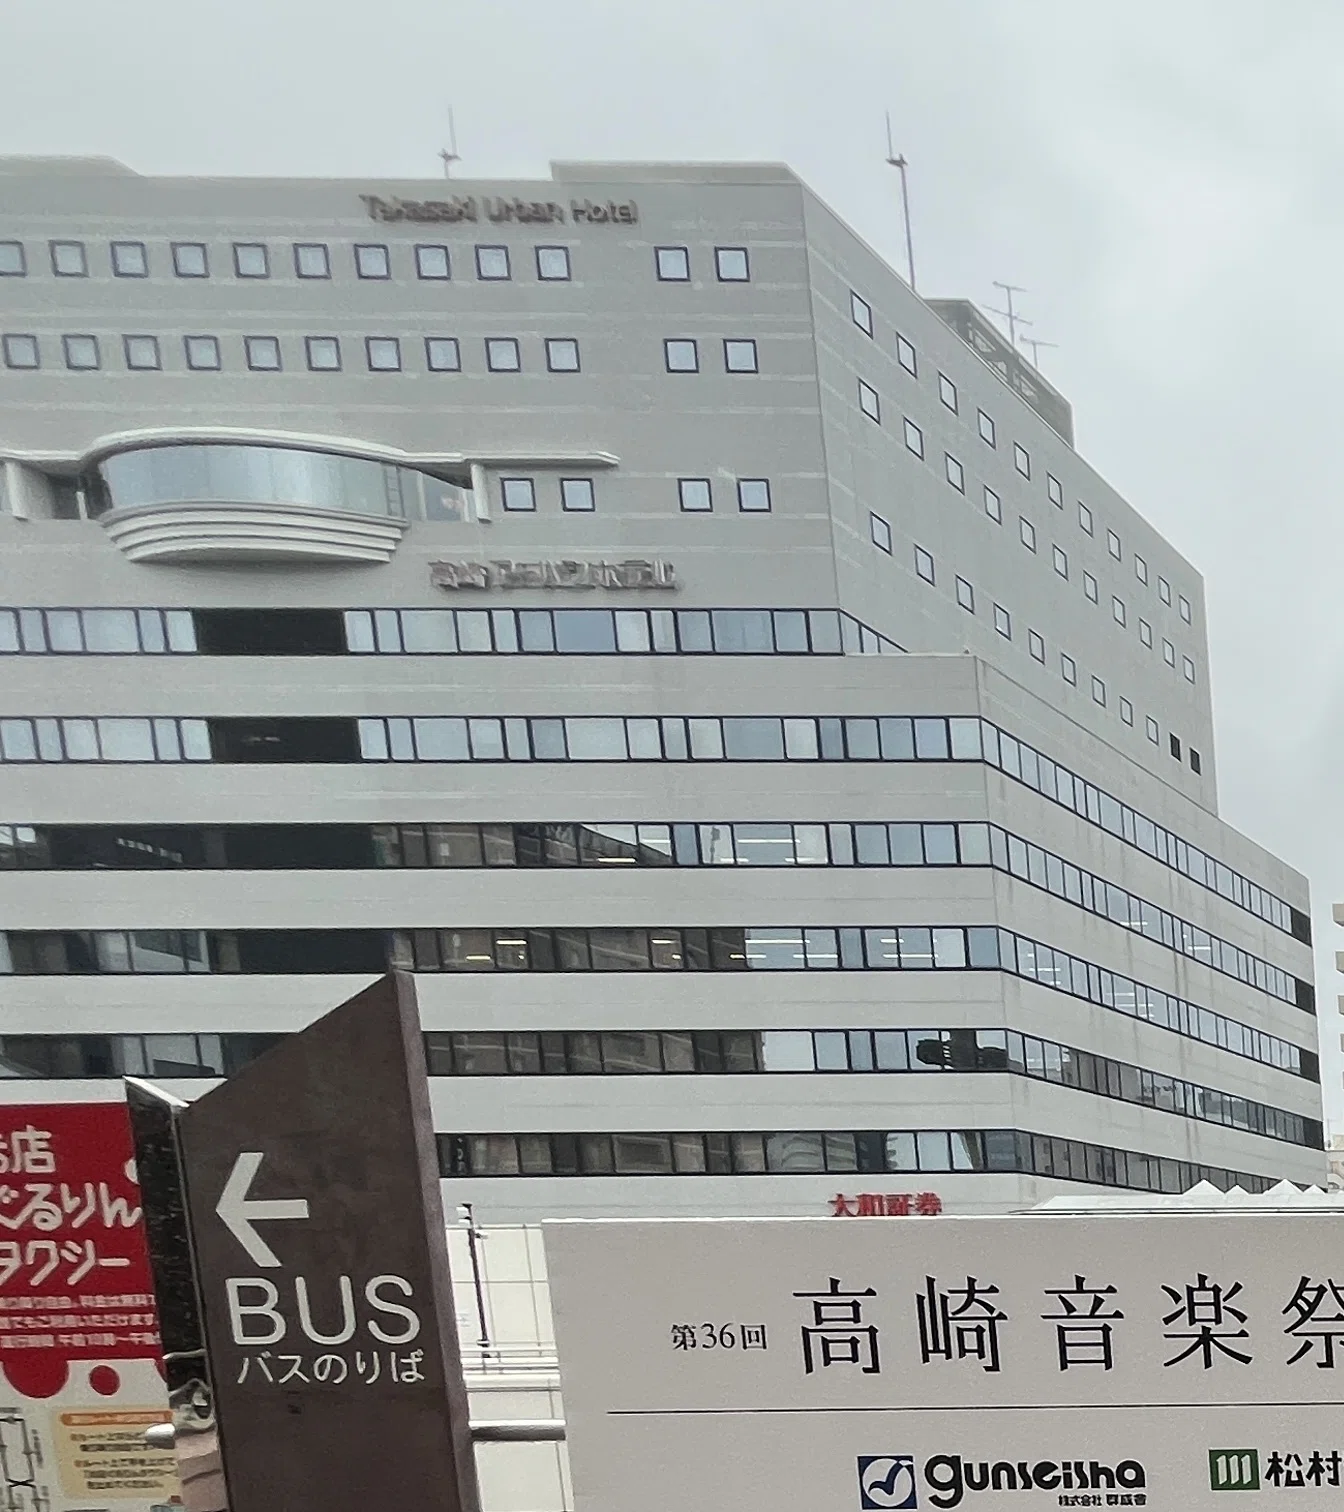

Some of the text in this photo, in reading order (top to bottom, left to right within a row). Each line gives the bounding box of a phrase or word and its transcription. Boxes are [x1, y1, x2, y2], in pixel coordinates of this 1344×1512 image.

[0, 1124, 56, 1173] 店
[226, 1275, 421, 1346] BUS
[671, 1323, 767, 1350] 第36回
[236, 1350, 425, 1384] バスのりば
[924, 1455, 1146, 1509] gunseisha
